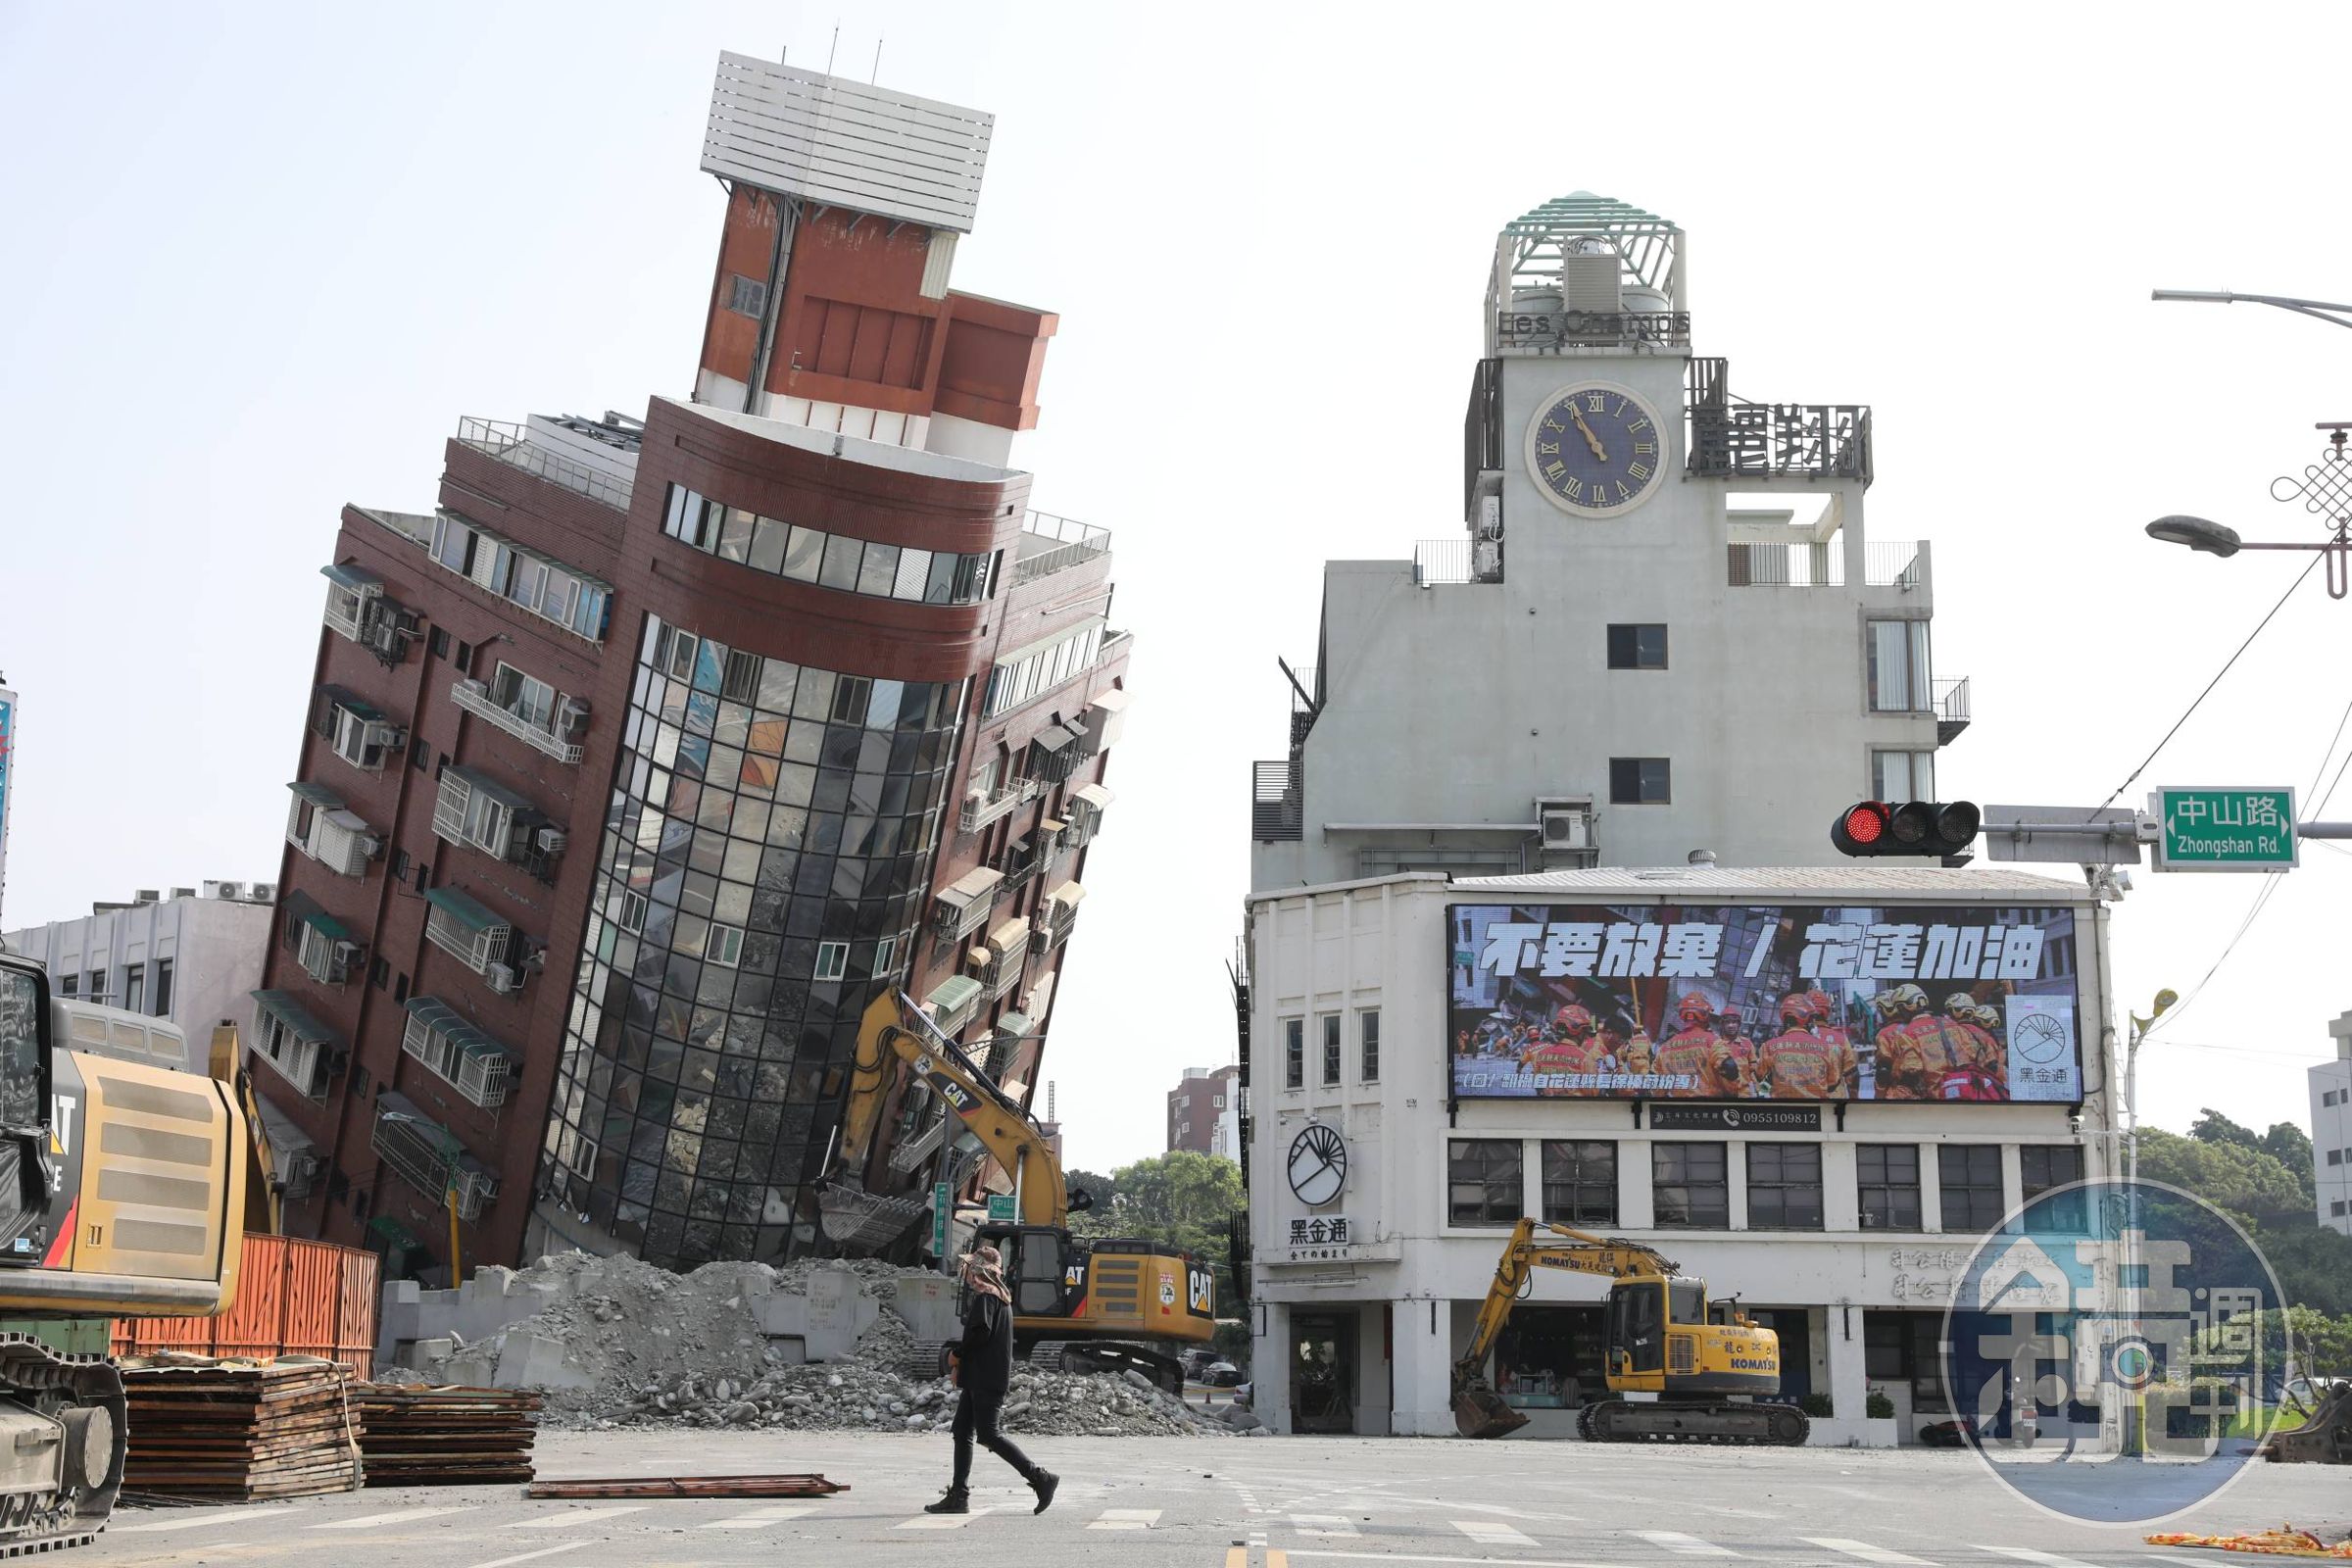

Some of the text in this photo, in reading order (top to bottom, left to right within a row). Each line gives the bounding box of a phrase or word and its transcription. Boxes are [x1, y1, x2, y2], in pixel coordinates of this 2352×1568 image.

[1497, 309, 1690, 339] Les Champs
[2177, 795, 2278, 827] 中山路
[2178, 835, 2280, 859] Zhongshan Rd.
[1479, 921, 1724, 978] 不要放棄
[1798, 922, 2045, 980] 花蓮加油
[2019, 1066, 2068, 1084] 黑金通
[943, 1081, 969, 1108] CAT
[51, 1093, 76, 1156] AT
[1742, 1112, 1817, 1124] 0955109812
[1290, 1218, 1348, 1245] 黑金通
[1290, 1249, 1348, 1261] 全ての始まり
[1541, 1255, 1581, 1270] KOMATSU
[1065, 1266, 1085, 1286] AT
[1189, 1269, 1212, 1313] CAT
[1731, 1357, 1777, 1371] KOMATSU
